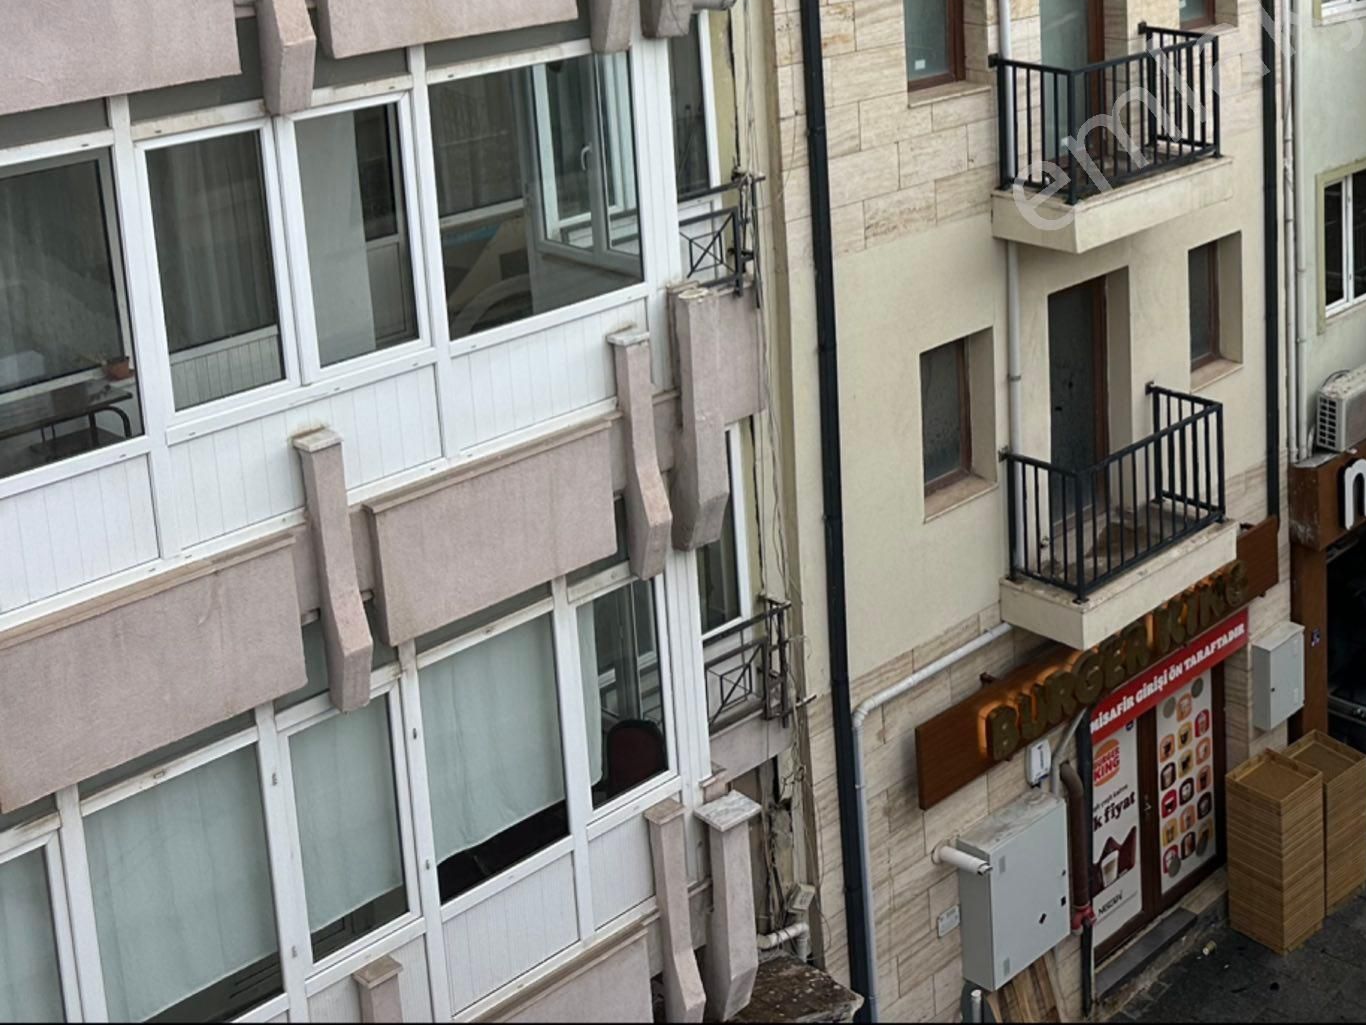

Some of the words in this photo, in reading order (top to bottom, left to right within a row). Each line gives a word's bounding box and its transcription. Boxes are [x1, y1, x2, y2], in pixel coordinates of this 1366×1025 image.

[1168, 662, 1183, 683] ÖN
[1183, 623, 1245, 672] TARAFTADIR
[1093, 757, 1120, 782] KING
[1104, 791, 1136, 824] fiyat
